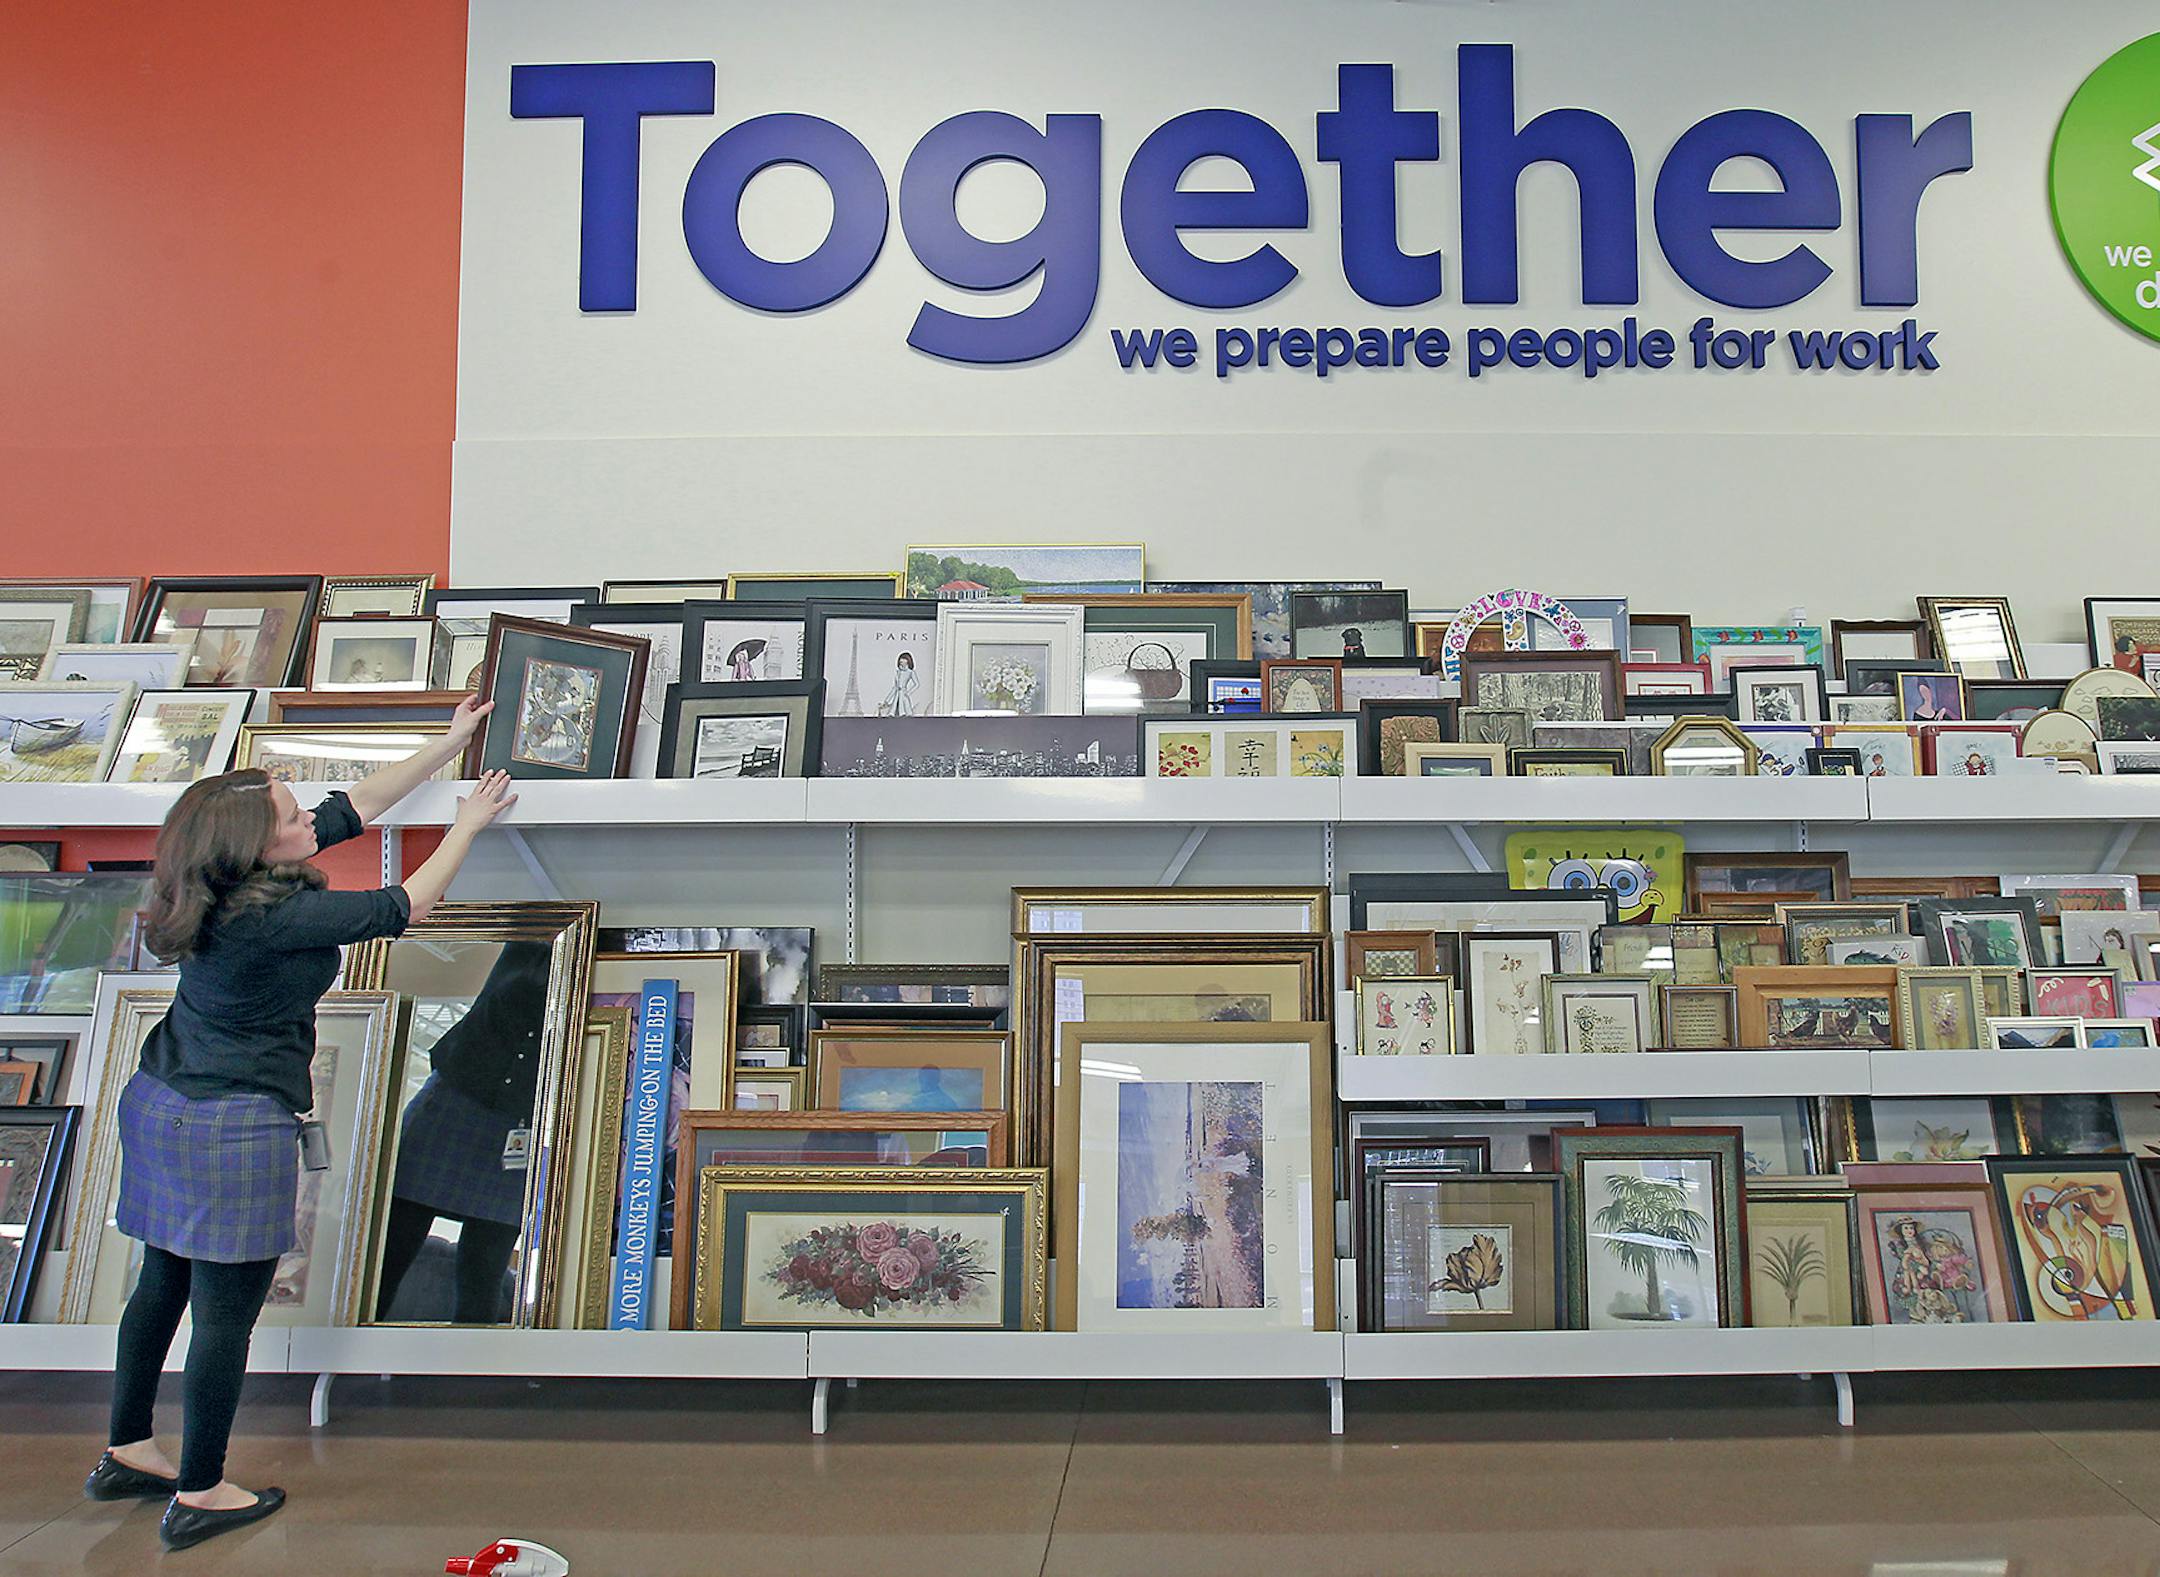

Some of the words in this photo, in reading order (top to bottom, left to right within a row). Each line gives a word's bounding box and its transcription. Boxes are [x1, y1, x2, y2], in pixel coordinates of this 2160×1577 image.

[510, 43, 1974, 363] Together
[2104, 245, 2152, 267] we
[1110, 327, 1198, 368] we
[1216, 327, 1450, 377] prepare
[1467, 317, 1675, 377] people
[1690, 317, 1775, 369] for
[1788, 319, 1940, 370] work
[1477, 591, 1543, 613] LOVE
[875, 632, 929, 641] PARIS
[646, 995, 668, 1029] BED
[644, 1032, 664, 1065] THE
[640, 1068, 661, 1094] ON
[633, 1095, 659, 1175] JUMPING
[1265, 1082, 1278, 1308] MONET
[625, 1178, 652, 1264] MONKEYS
[619, 1269, 643, 1323] MORE
